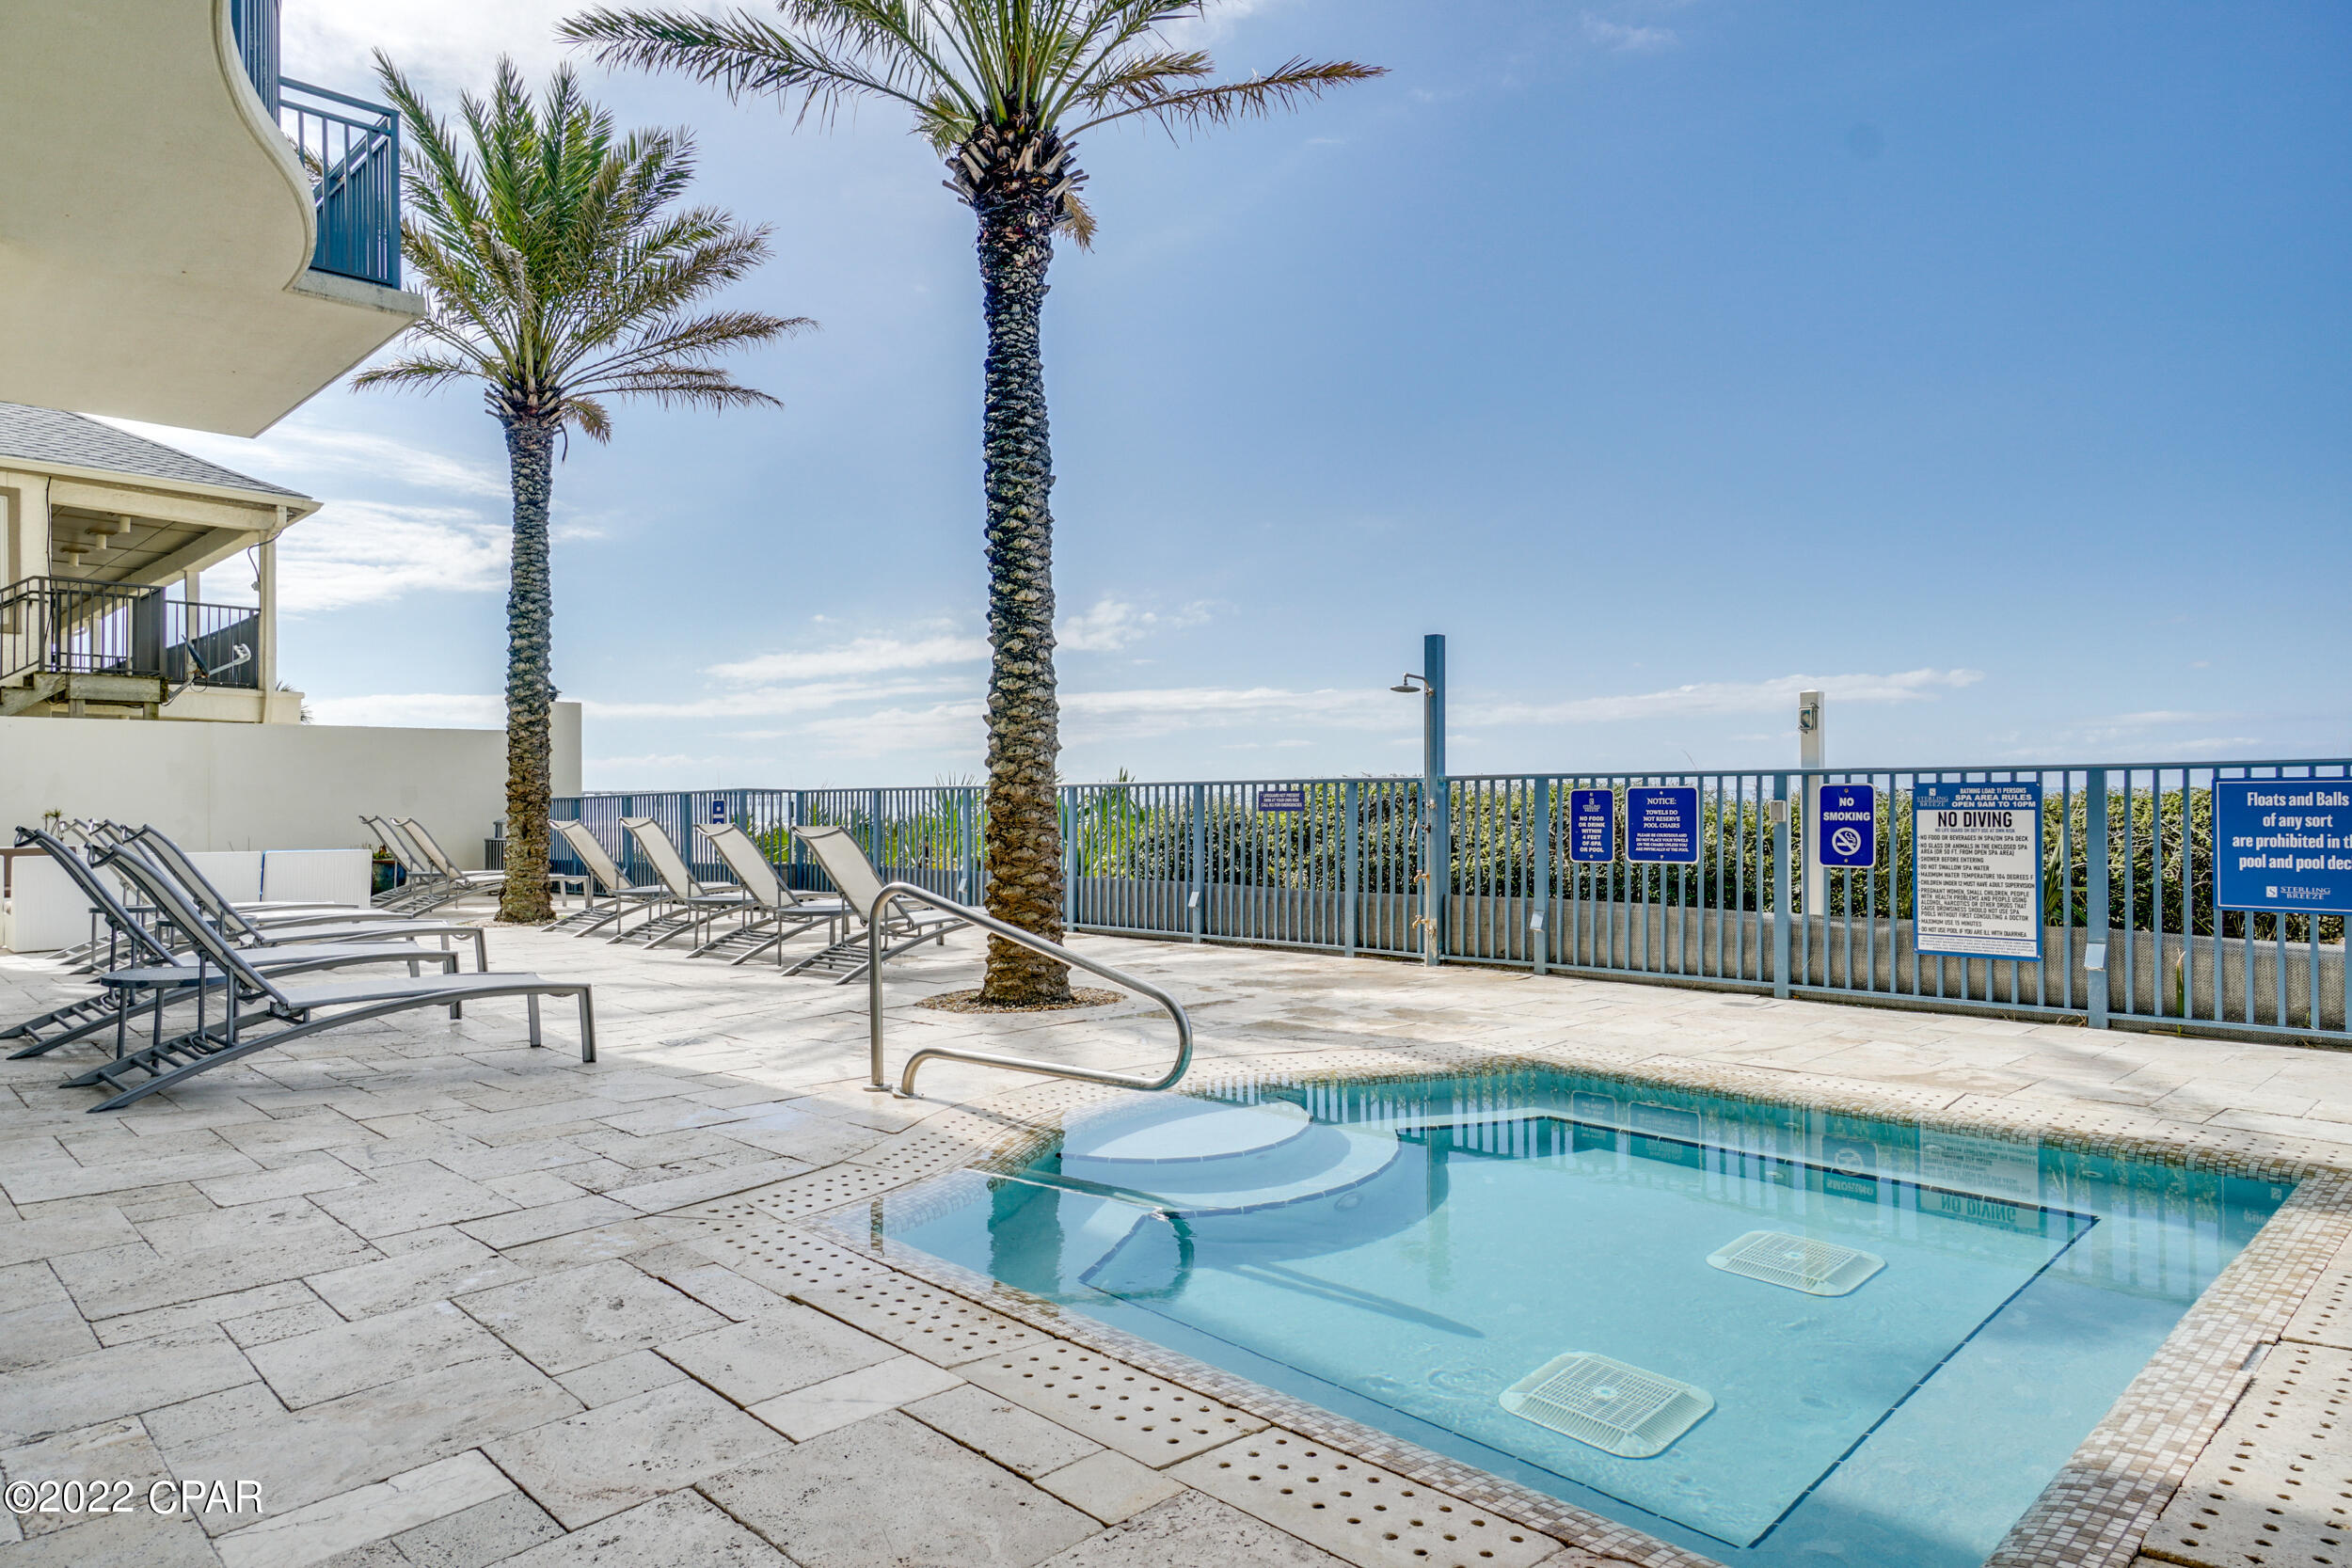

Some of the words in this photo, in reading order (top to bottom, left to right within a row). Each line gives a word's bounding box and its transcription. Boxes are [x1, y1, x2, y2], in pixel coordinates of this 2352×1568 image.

[1839, 798, 1854, 806] NO
[2247, 792, 2286, 806] Floats
[2289, 792, 2313, 806] and
[2316, 792, 2349, 806] Balls
[1823, 812, 1870, 821] SMOKING
[1938, 812, 1957, 827] NO
[1964, 812, 2012, 827] DIVING
[2263, 813, 2276, 827] of
[2278, 816, 2302, 830] any
[2305, 815, 2333, 827] sort
[2232, 837, 2253, 847] are
[2256, 834, 2324, 850] prohibited
[2328, 834, 2340, 848] in
[2239, 854, 2266, 871] pool
[2269, 855, 2293, 868] and
[2296, 855, 2324, 872] pool
